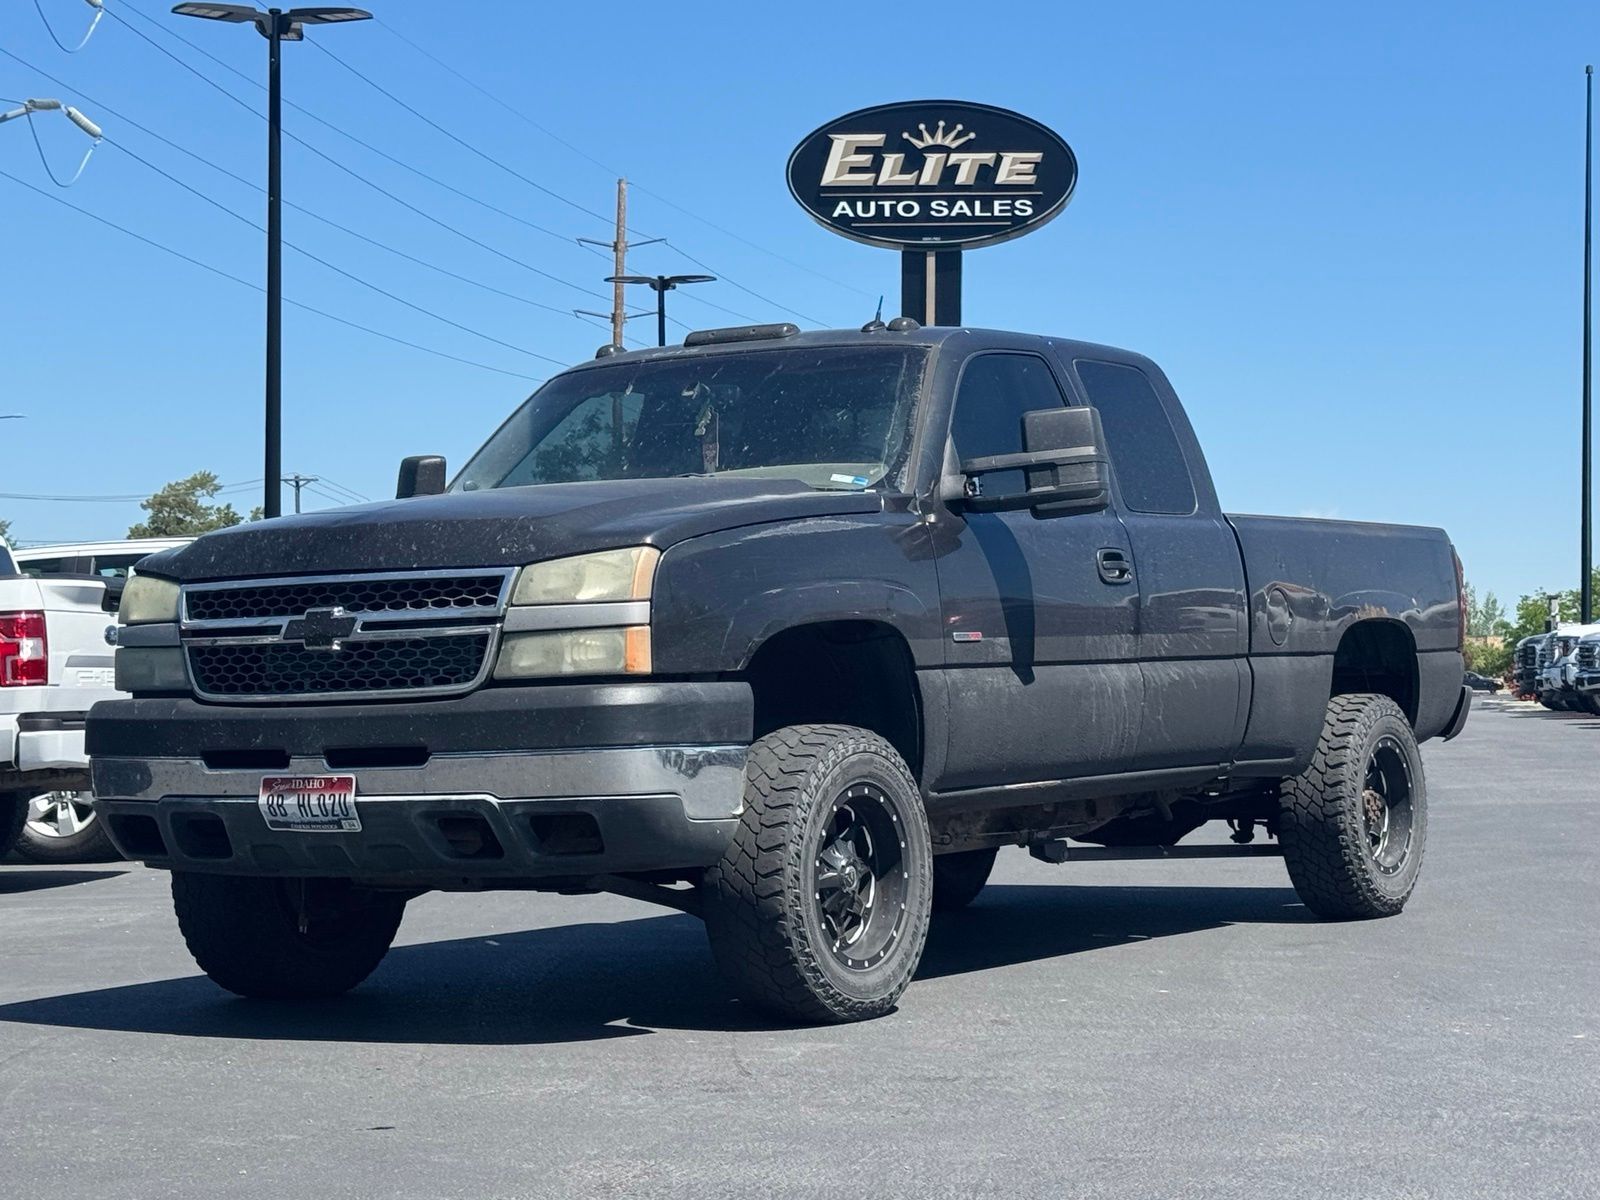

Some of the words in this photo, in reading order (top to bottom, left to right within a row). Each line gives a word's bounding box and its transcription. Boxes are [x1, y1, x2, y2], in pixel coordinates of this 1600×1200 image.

[820, 133, 1044, 187] ELITE
[832, 200, 920, 218] AUTO
[929, 199, 1034, 217] SALES
[291, 779, 326, 789] IDAHO
[267, 793, 288, 817] 8B
